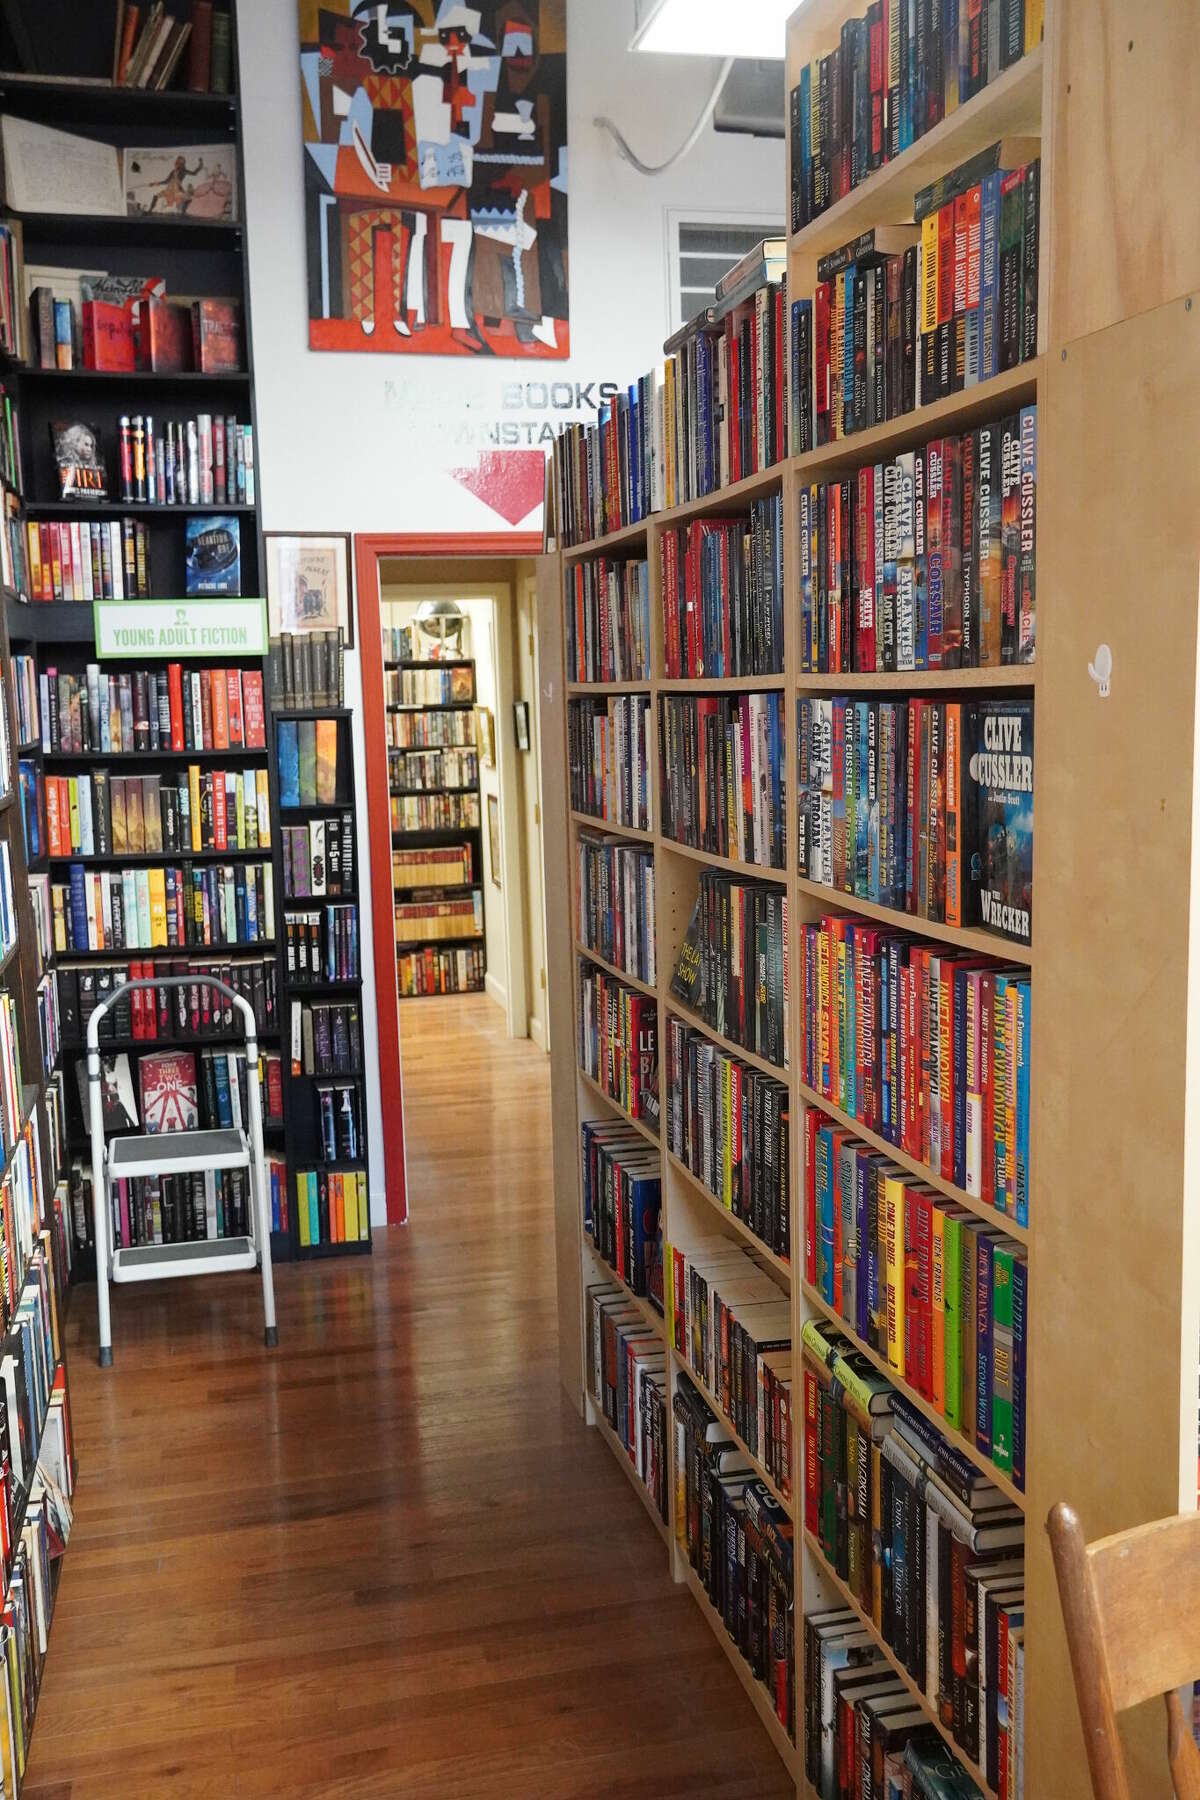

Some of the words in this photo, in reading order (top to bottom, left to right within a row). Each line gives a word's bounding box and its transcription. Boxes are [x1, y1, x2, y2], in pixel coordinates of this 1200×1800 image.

[891, 35, 900, 82] GRISHAM
[968, 223, 980, 253] JOHN
[984, 215, 994, 240] JOHN
[926, 251, 936, 278] JOHN
[967, 256, 980, 304] GRISHAM
[984, 242, 994, 287] GRISHAM
[926, 280, 936, 328] GRISHAM
[970, 312, 978, 332] GRAY
[984, 294, 994, 312] THE
[970, 334, 978, 375] MOUNTAIN
[984, 314, 994, 374] CONFESSION
[963, 434, 973, 484] CLIVE
[980, 430, 990, 480] CLIVE
[1022, 415, 1034, 468] CLIVE
[916, 458, 924, 496] CLIVE
[930, 451, 938, 499] CUSSLER
[1002, 432, 1010, 498] CUSSLER
[1010, 440, 1020, 486] CLIVE
[885, 465, 898, 506] CLIVE
[901, 476, 912, 537] CLIVE
[916, 500, 924, 555] CUSSLER
[963, 486, 973, 547] CUSSLER
[980, 484, 990, 561] CUSSLER
[1021, 471, 1034, 552] CUSSLER
[884, 508, 898, 560] CUSSLER
[864, 587, 872, 628] WHITE
[884, 594, 894, 620] LOST
[930, 552, 942, 636] CORSAIR
[962, 566, 970, 618] TYPHOON
[884, 622, 894, 646] CITY
[902, 572, 914, 656] ATLANTIS
[962, 620, 970, 649] FURY
[113, 628, 155, 647] YOUNG
[159, 628, 198, 646] ADULT
[200, 626, 248, 645] FICTION
[930, 710, 938, 754] CLIVE
[984, 716, 1022, 752] CLIVE
[930, 759, 938, 827] CUSSLER
[978, 752, 1033, 792] CUSSLER
[812, 795, 820, 848] TROJAN
[822, 800, 832, 874] ATLANTIS
[342, 835, 352, 872] INFINITE
[112, 896, 120, 940] DIVERGENT
[768, 898, 776, 942] PATRICIA
[980, 888, 1030, 937] WRECKER
[822, 931, 830, 957] JANET
[678, 964, 696, 985] SHOW
[768, 944, 776, 1000] CORNWELL
[822, 958, 830, 1006] EVANOVICH
[862, 954, 872, 992] JANET
[940, 982, 950, 1020] JANET
[967, 980, 976, 1016] JANET
[994, 994, 1008, 1044] JANET
[1016, 993, 1024, 1020] Janet
[640, 1030, 655, 1052] LE
[862, 995, 872, 1067] EVANOVICH
[1016, 1021, 1024, 1068] Evanovich
[940, 1024, 950, 1104] EVANOVICH
[967, 1019, 976, 1086] EVANOVICH
[156, 1080, 182, 1092] ONE
[890, 1074, 898, 1125] SEVENTEEN
[994, 1048, 1008, 1142] EVANOVICH
[841, 1159, 852, 1224] STRAIGHT
[996, 1156, 1006, 1188] PLUM
[1016, 1164, 1026, 1206] CHASE
[887, 1200, 896, 1228] COME
[887, 1229, 896, 1238] TO
[918, 1208, 928, 1242] DICK
[887, 1240, 896, 1267] GRIEF
[934, 1234, 942, 1260] DICK
[979, 1247, 989, 1278] DICK
[887, 1283, 896, 1302] DICK
[918, 1246, 928, 1304] FRANCIS
[934, 1263, 942, 1302] FRANCIS
[887, 1304, 896, 1344] FRANCIS
[978, 1282, 989, 1334] FRANCIS
[978, 1353, 987, 1396] SECOND
[994, 1348, 1008, 1386] BOLT
[978, 1398, 987, 1429] WIND
[894, 1497, 902, 1529] JOHN
[894, 1566, 902, 1592] TIME
[895, 1555, 902, 1564] A
[894, 1594, 902, 1616] FOR
